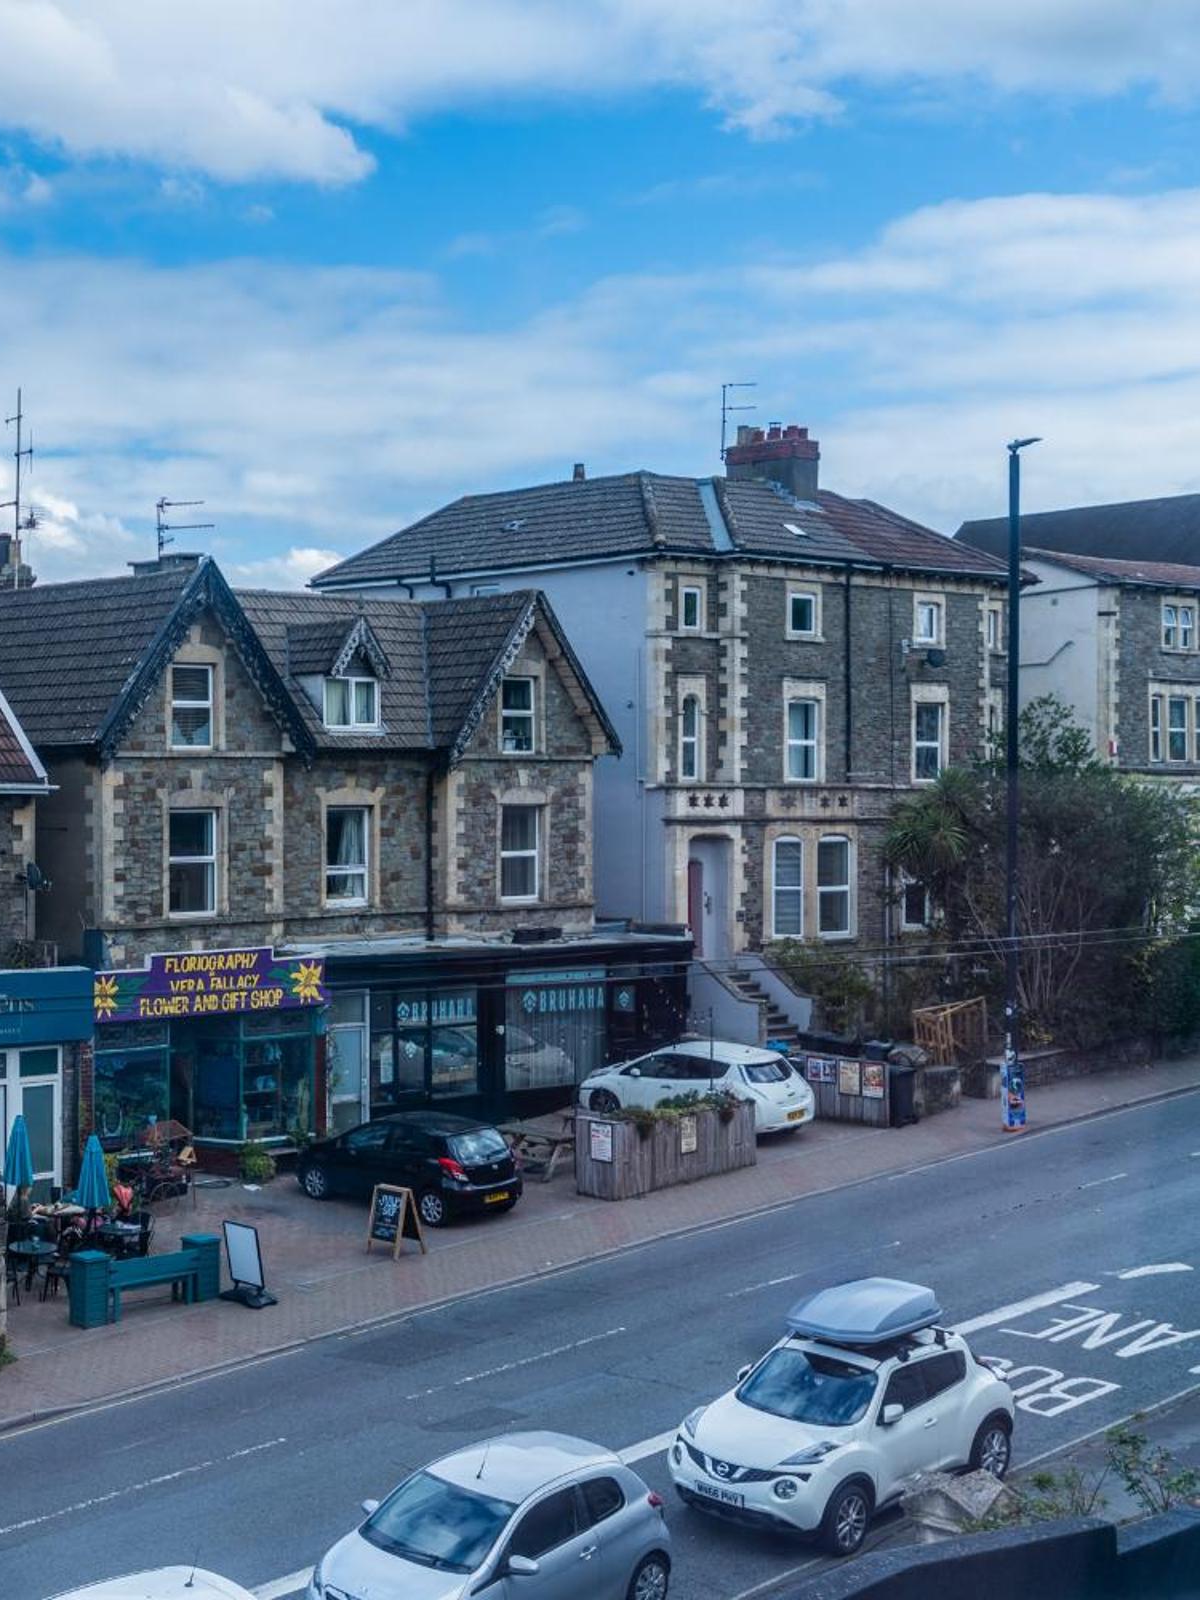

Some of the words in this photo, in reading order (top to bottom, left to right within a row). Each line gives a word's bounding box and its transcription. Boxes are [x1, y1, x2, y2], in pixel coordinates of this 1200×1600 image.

[164, 952, 258, 973] FLORIOGRAPHY
[169, 977, 205, 992] VERA
[210, 973, 260, 989] FALLACY
[139, 996, 190, 1017] FLOWER
[193, 996, 220, 1013] AND
[221, 991, 248, 1010] GIFT
[250, 988, 284, 1009] SHOP
[412, 998, 474, 1022] BRUHAHA
[539, 986, 605, 1012] BRUHAHA
[998, 1303, 1200, 1372] ANE
